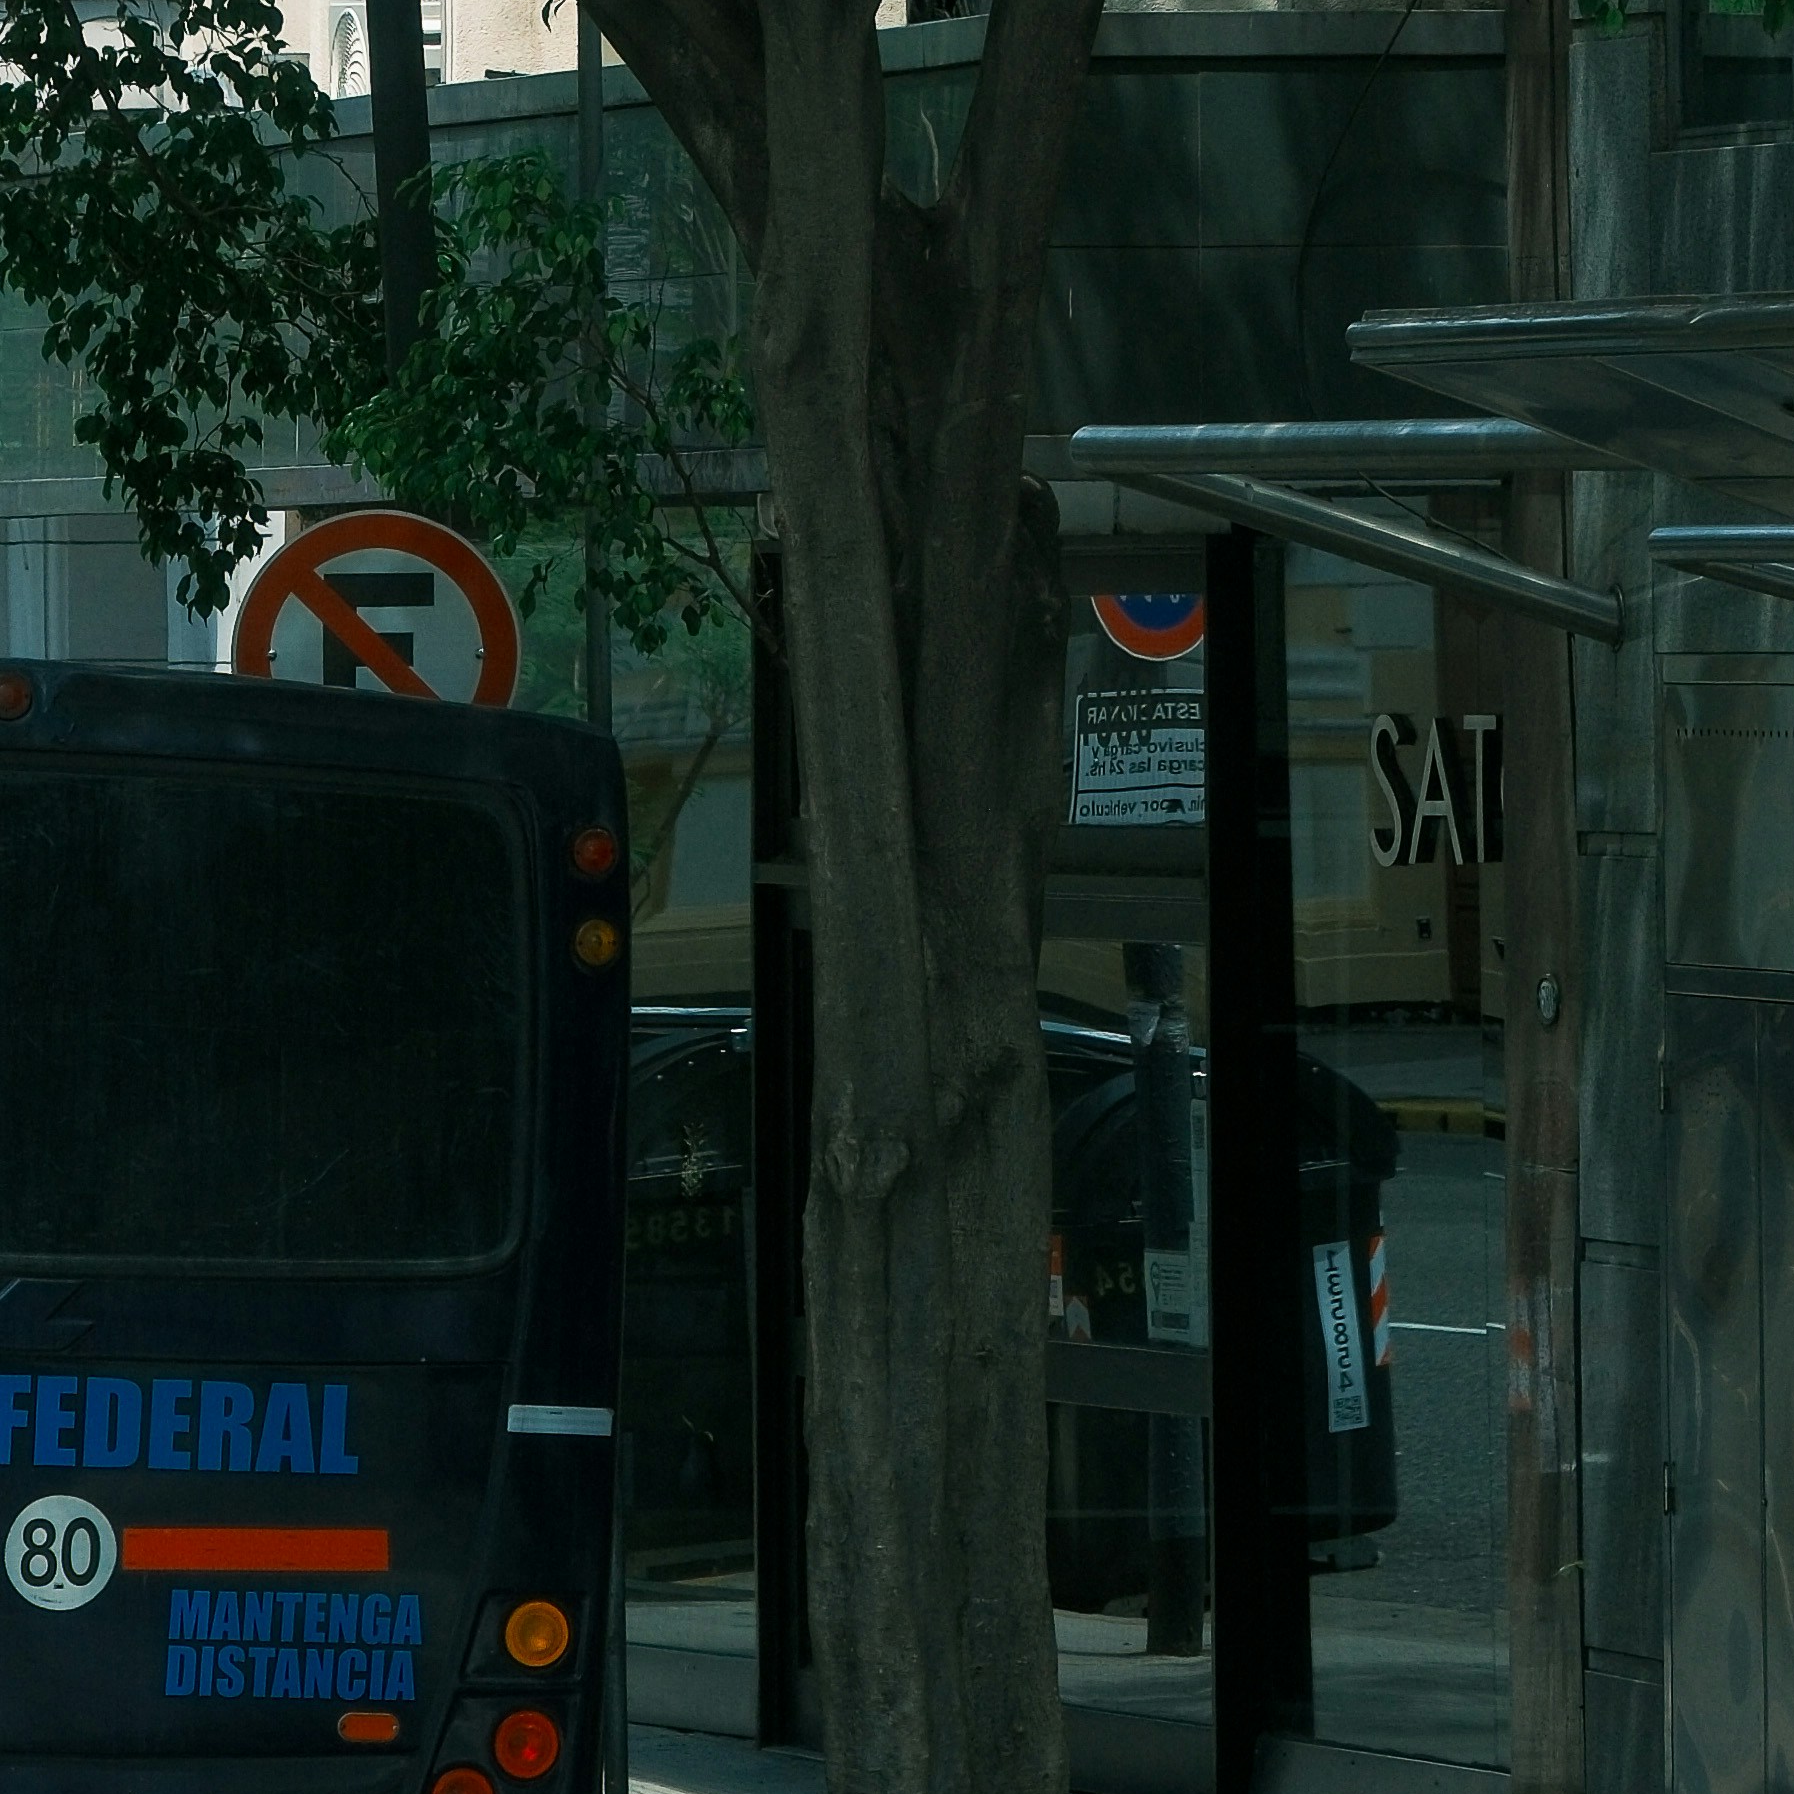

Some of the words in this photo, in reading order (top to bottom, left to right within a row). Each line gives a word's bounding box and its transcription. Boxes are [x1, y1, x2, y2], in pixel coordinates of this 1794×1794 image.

[0, 1375, 359, 1474] FEDERAL
[21, 1517, 101, 1587] 80
[169, 1589, 423, 1645] MANTENGA
[165, 1646, 415, 1702] DISTANCIA
